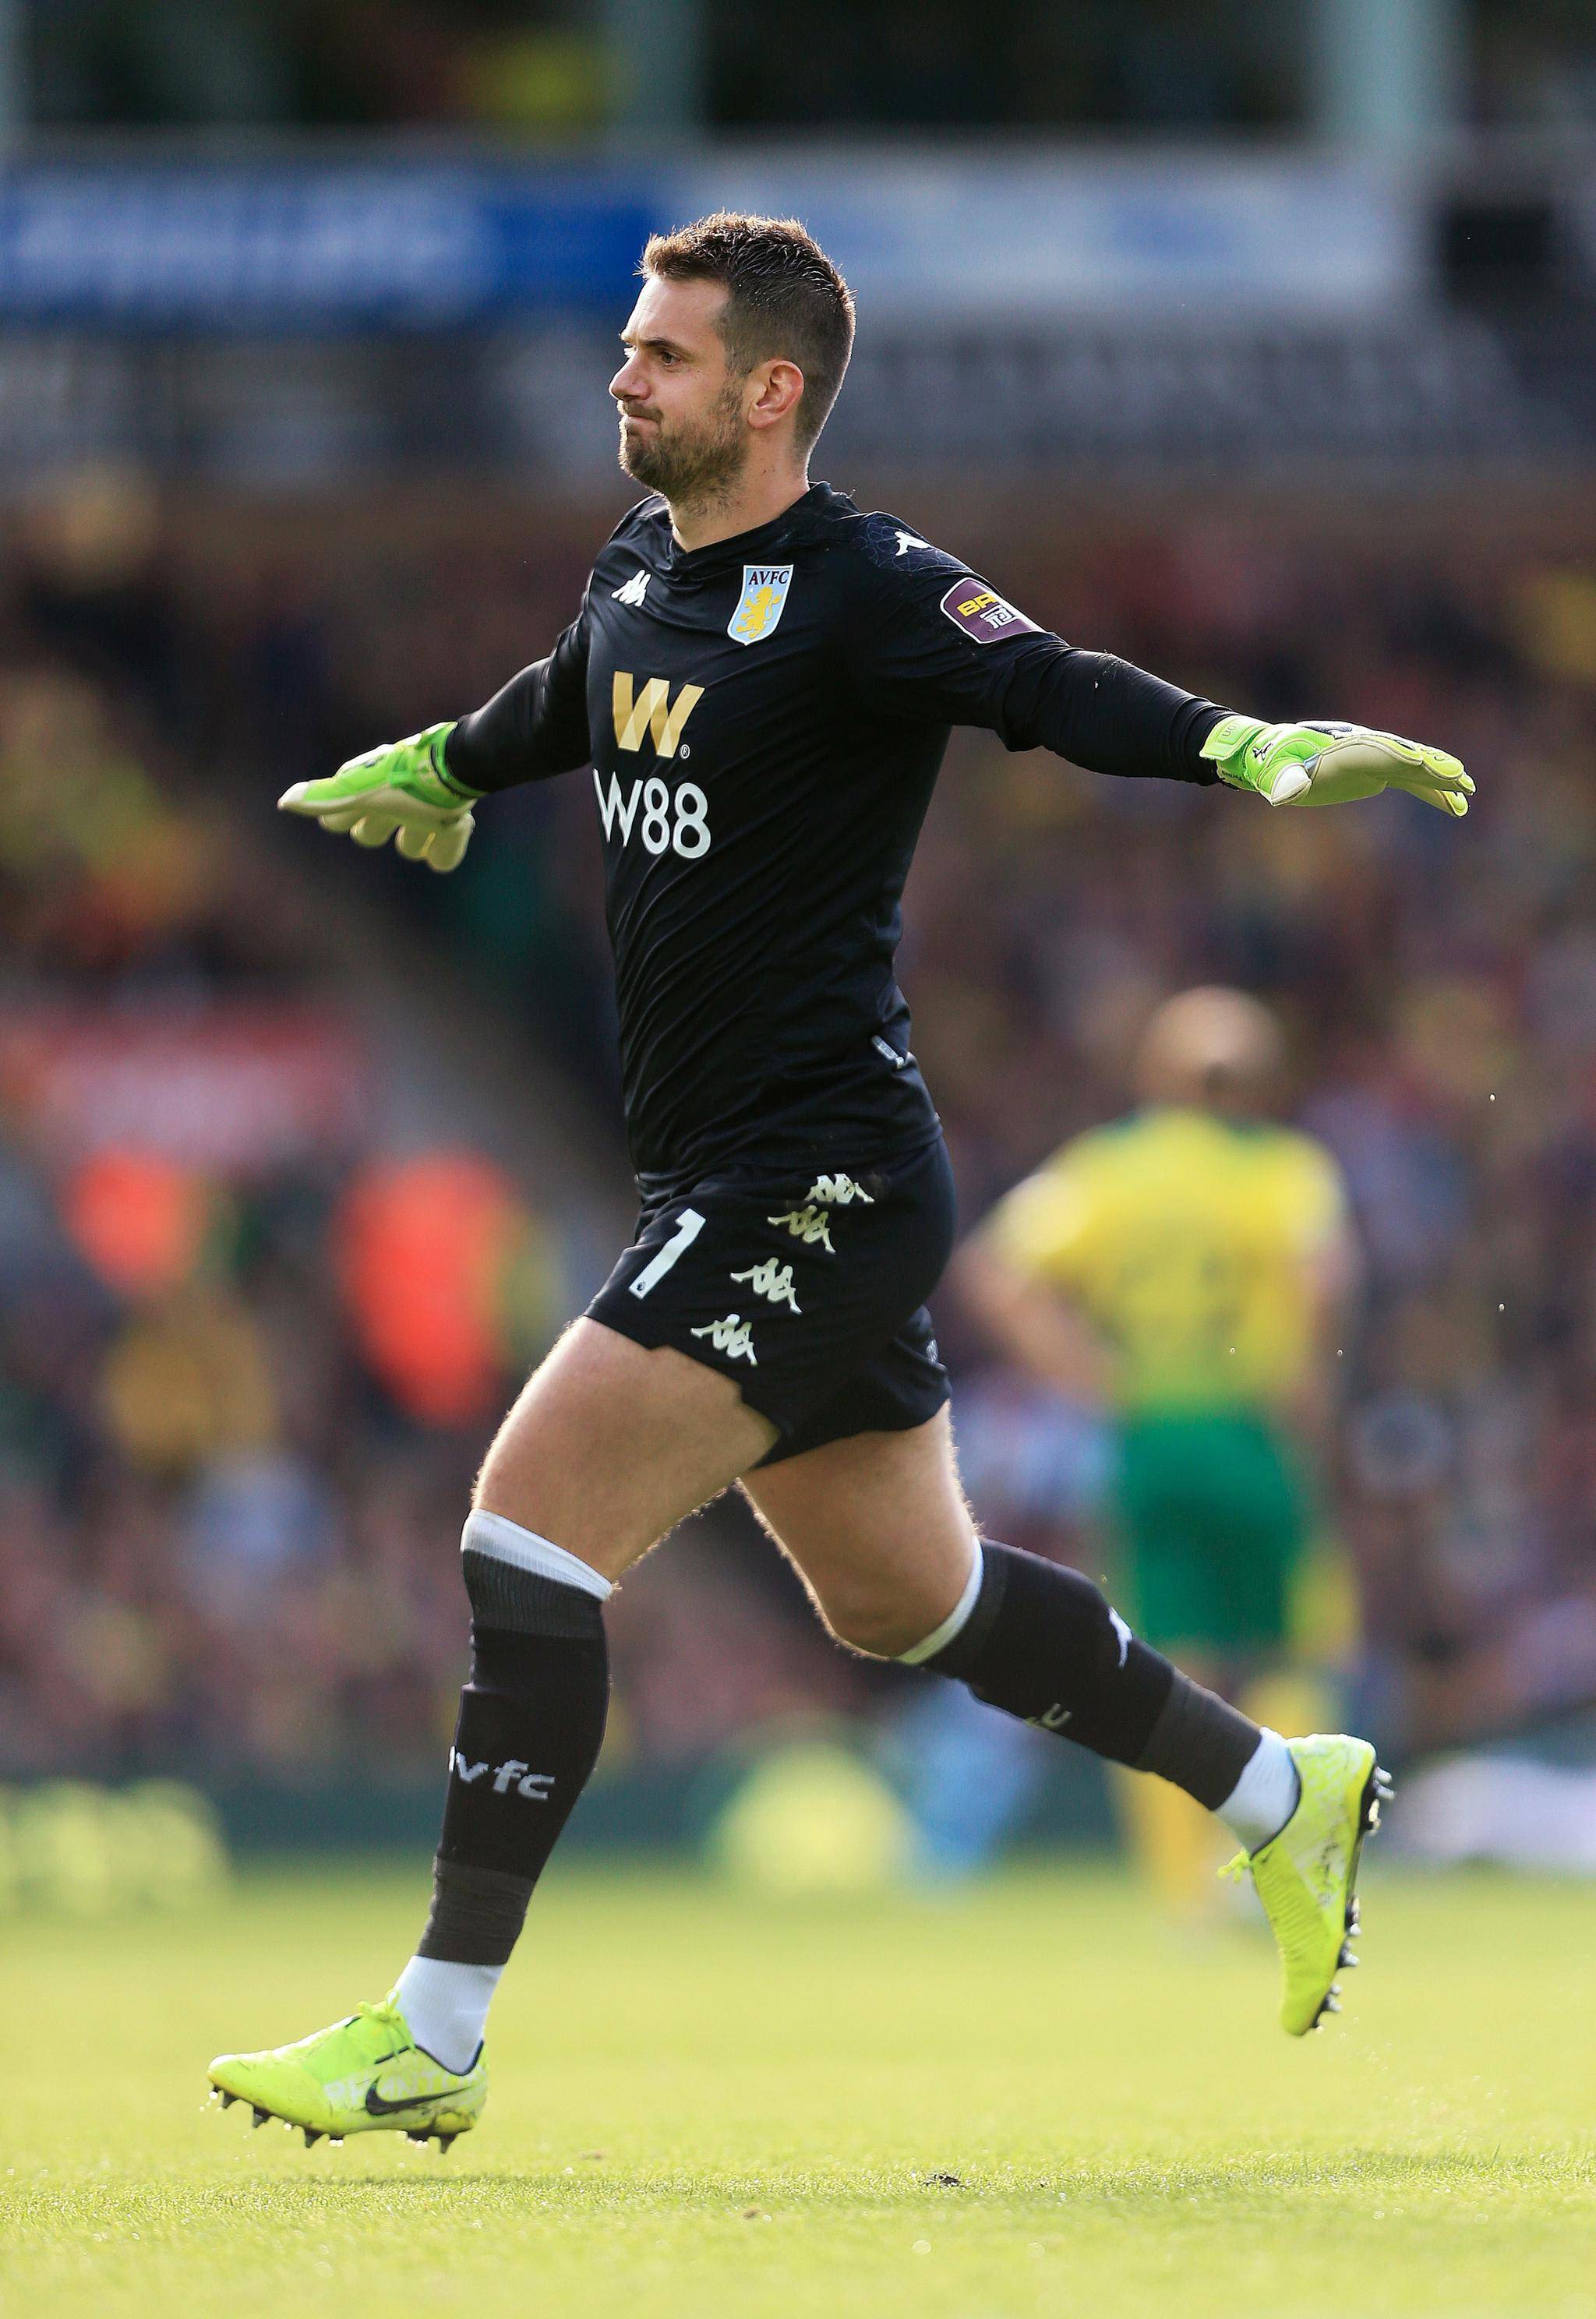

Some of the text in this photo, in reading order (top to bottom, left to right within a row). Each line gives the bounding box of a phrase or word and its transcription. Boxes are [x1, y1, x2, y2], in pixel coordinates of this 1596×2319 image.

[748, 570, 789, 585] AVFC
[592, 768, 711, 859] W88
[627, 1208, 707, 1300] 1
[448, 1745, 556, 1802] vfc
